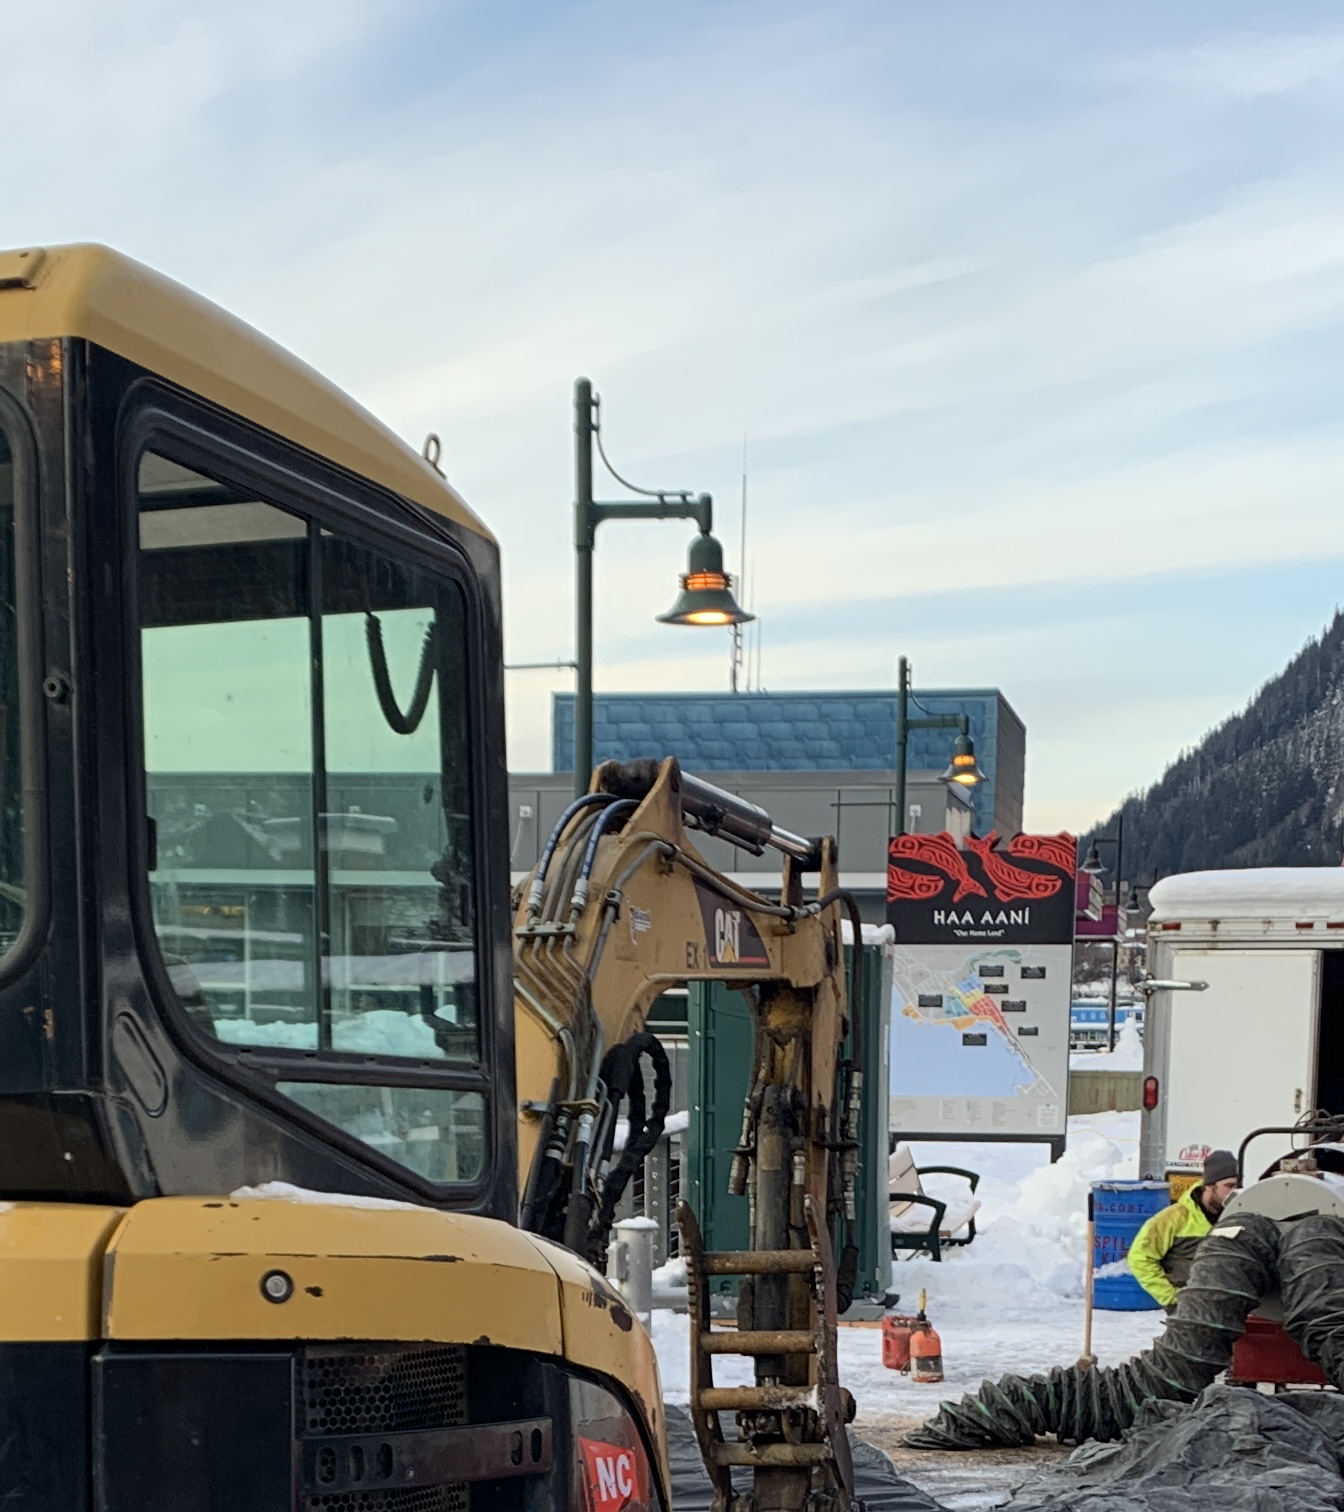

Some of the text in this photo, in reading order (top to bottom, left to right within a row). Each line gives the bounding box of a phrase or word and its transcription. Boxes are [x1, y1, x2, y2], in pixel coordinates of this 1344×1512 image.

[934, 907, 1030, 925] HAA AANÍ
[715, 908, 740, 963] CAT
[1094, 1234, 1129, 1251] SPIL
[595, 1453, 635, 1504] NC
